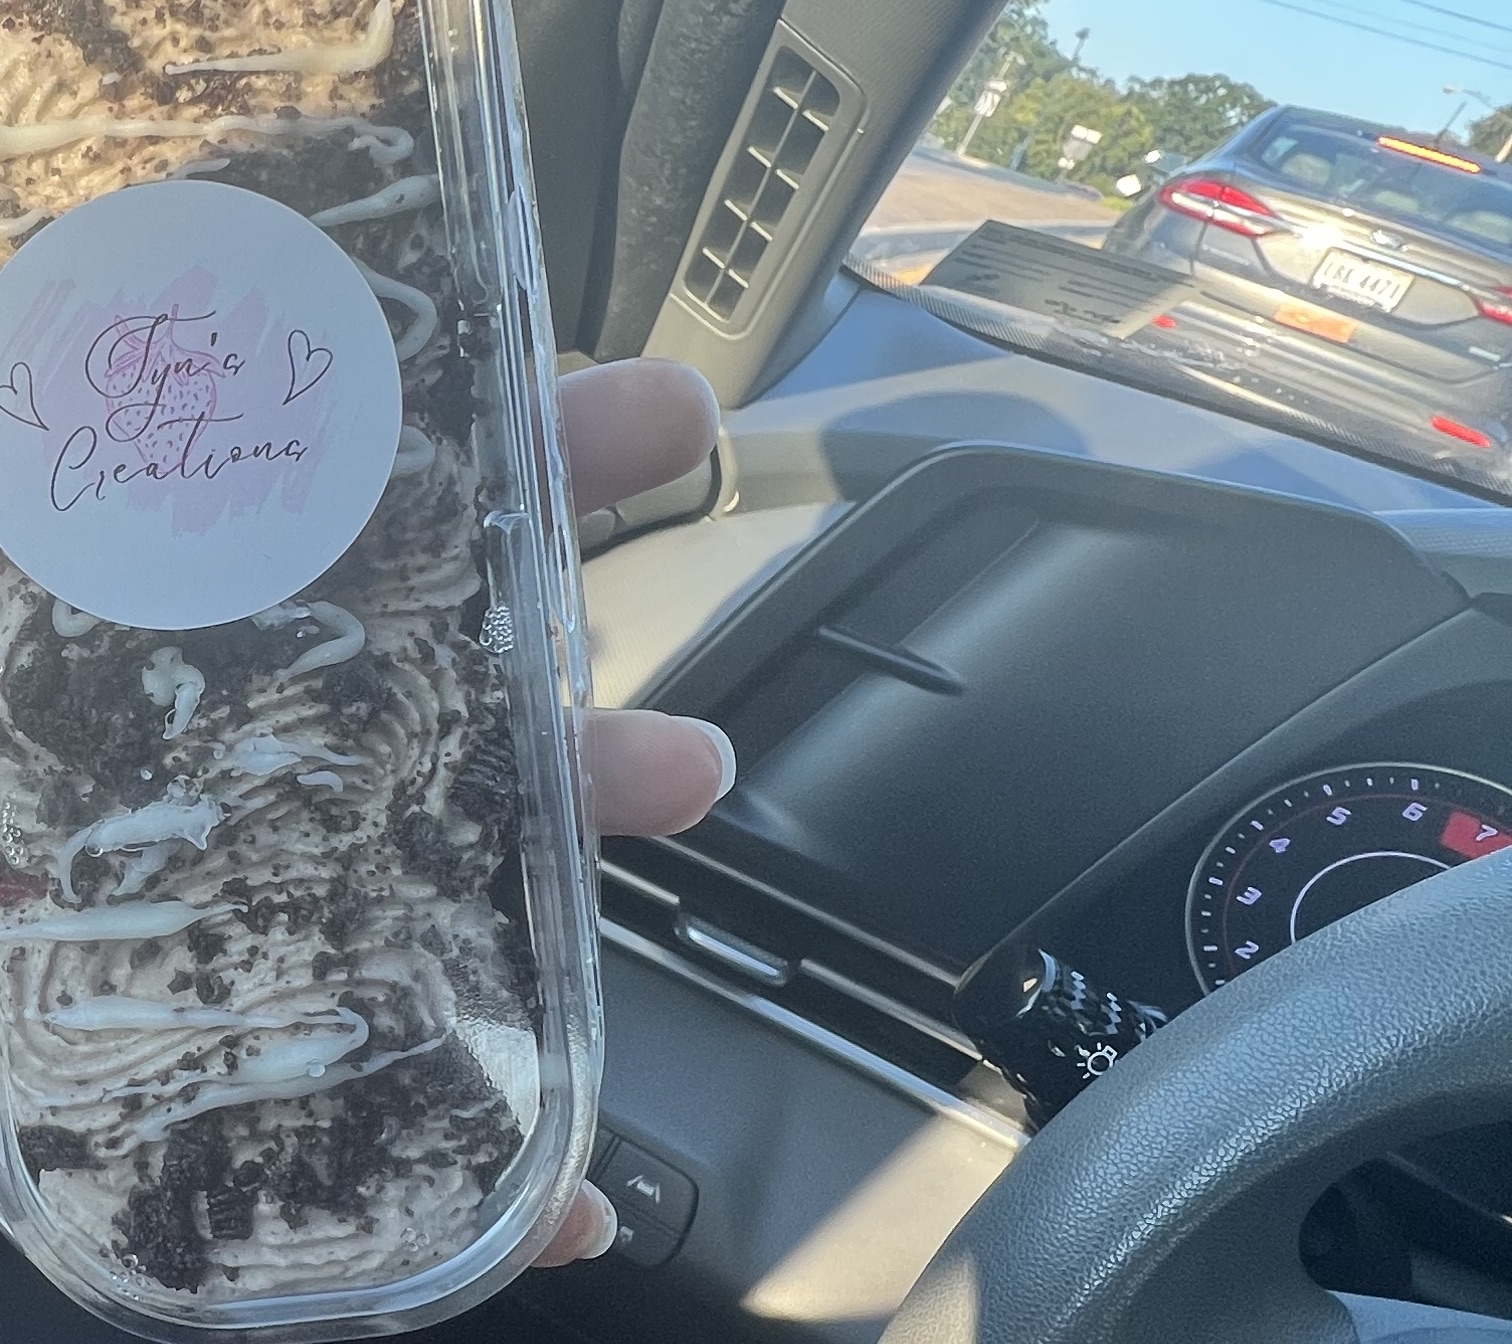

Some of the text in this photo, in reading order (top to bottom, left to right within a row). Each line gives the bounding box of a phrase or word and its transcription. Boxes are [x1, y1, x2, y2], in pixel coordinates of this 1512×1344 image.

[85, 310, 246, 442] Tyn's
[51, 411, 308, 511] Creations
[1326, 806, 1351, 826] 5
[1401, 801, 1428, 822] 6
[1475, 823, 1499, 842] 7
[1268, 837, 1291, 854] 4
[1235, 886, 1263, 906] 3
[1234, 940, 1260, 960] 2
